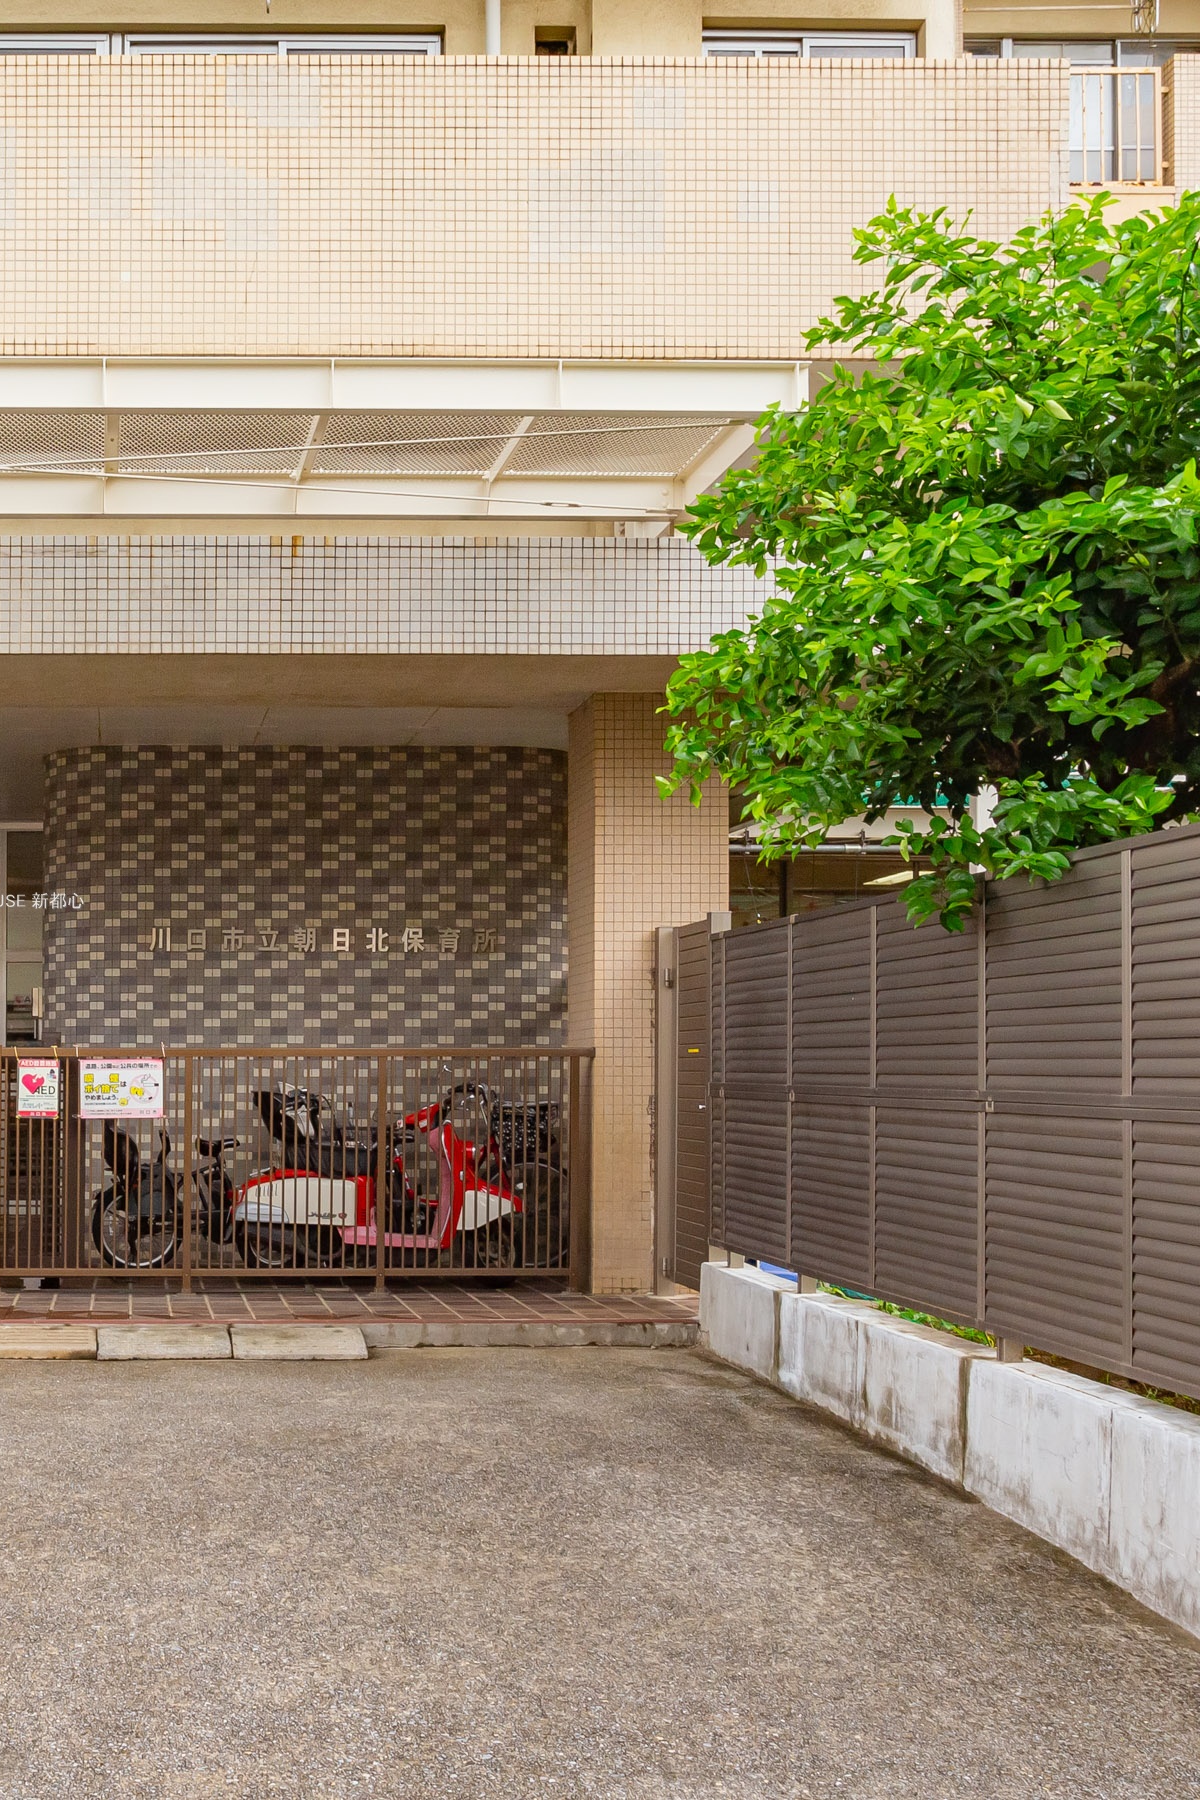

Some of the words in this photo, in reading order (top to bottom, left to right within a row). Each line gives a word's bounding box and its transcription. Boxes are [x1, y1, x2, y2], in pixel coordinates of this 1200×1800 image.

[149, 926, 498, 953] 川口市立朝日北保育所
[33, 1085, 56, 1095] AED
